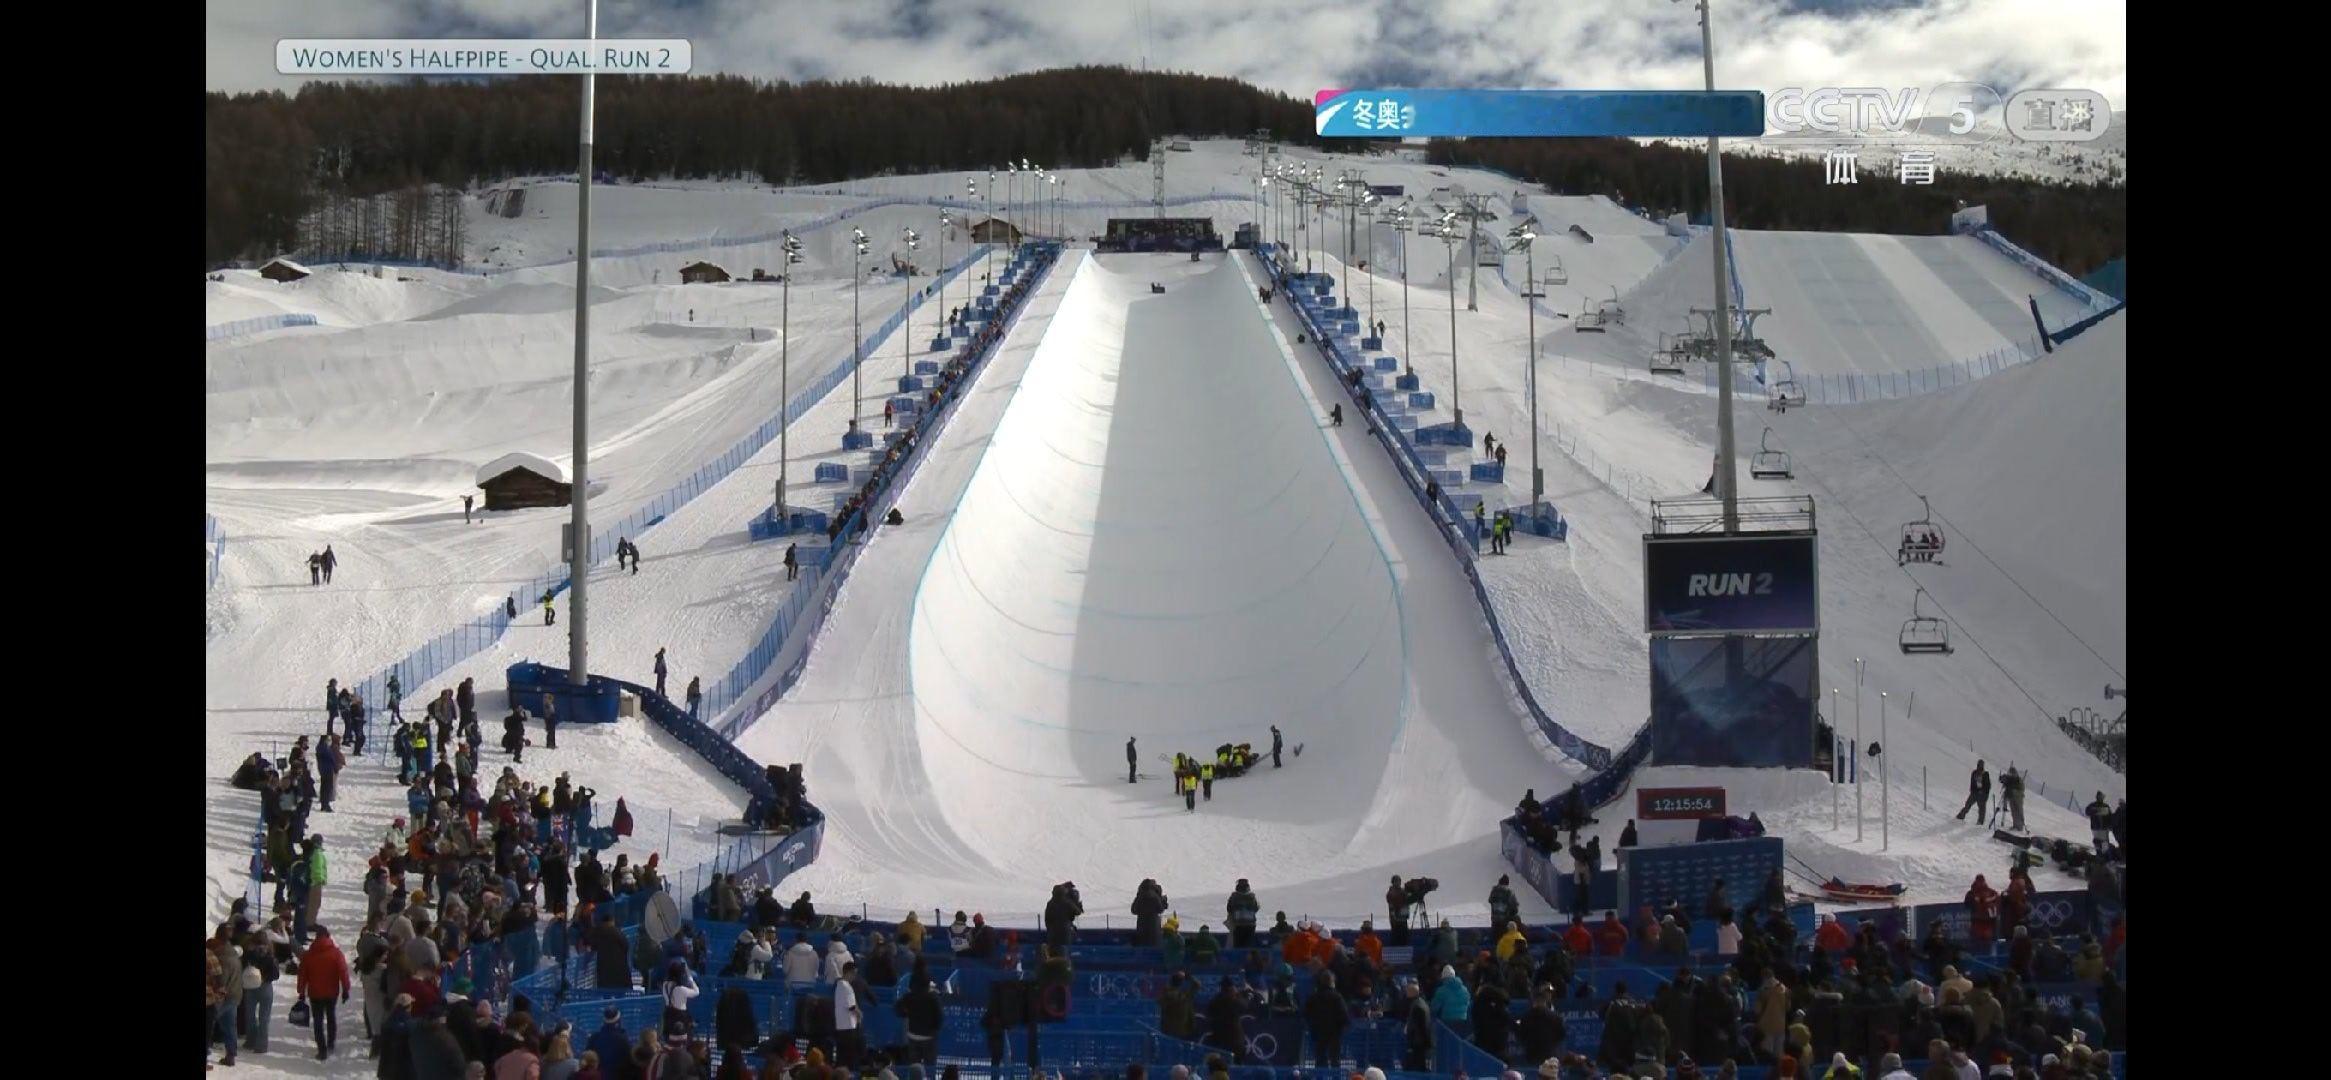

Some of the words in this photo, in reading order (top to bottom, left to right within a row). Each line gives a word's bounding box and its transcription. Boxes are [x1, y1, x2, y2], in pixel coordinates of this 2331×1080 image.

[1688, 573, 1752, 597] RUN
[1754, 572, 1774, 595] 2
[1654, 798, 1713, 811] 12:15:54
